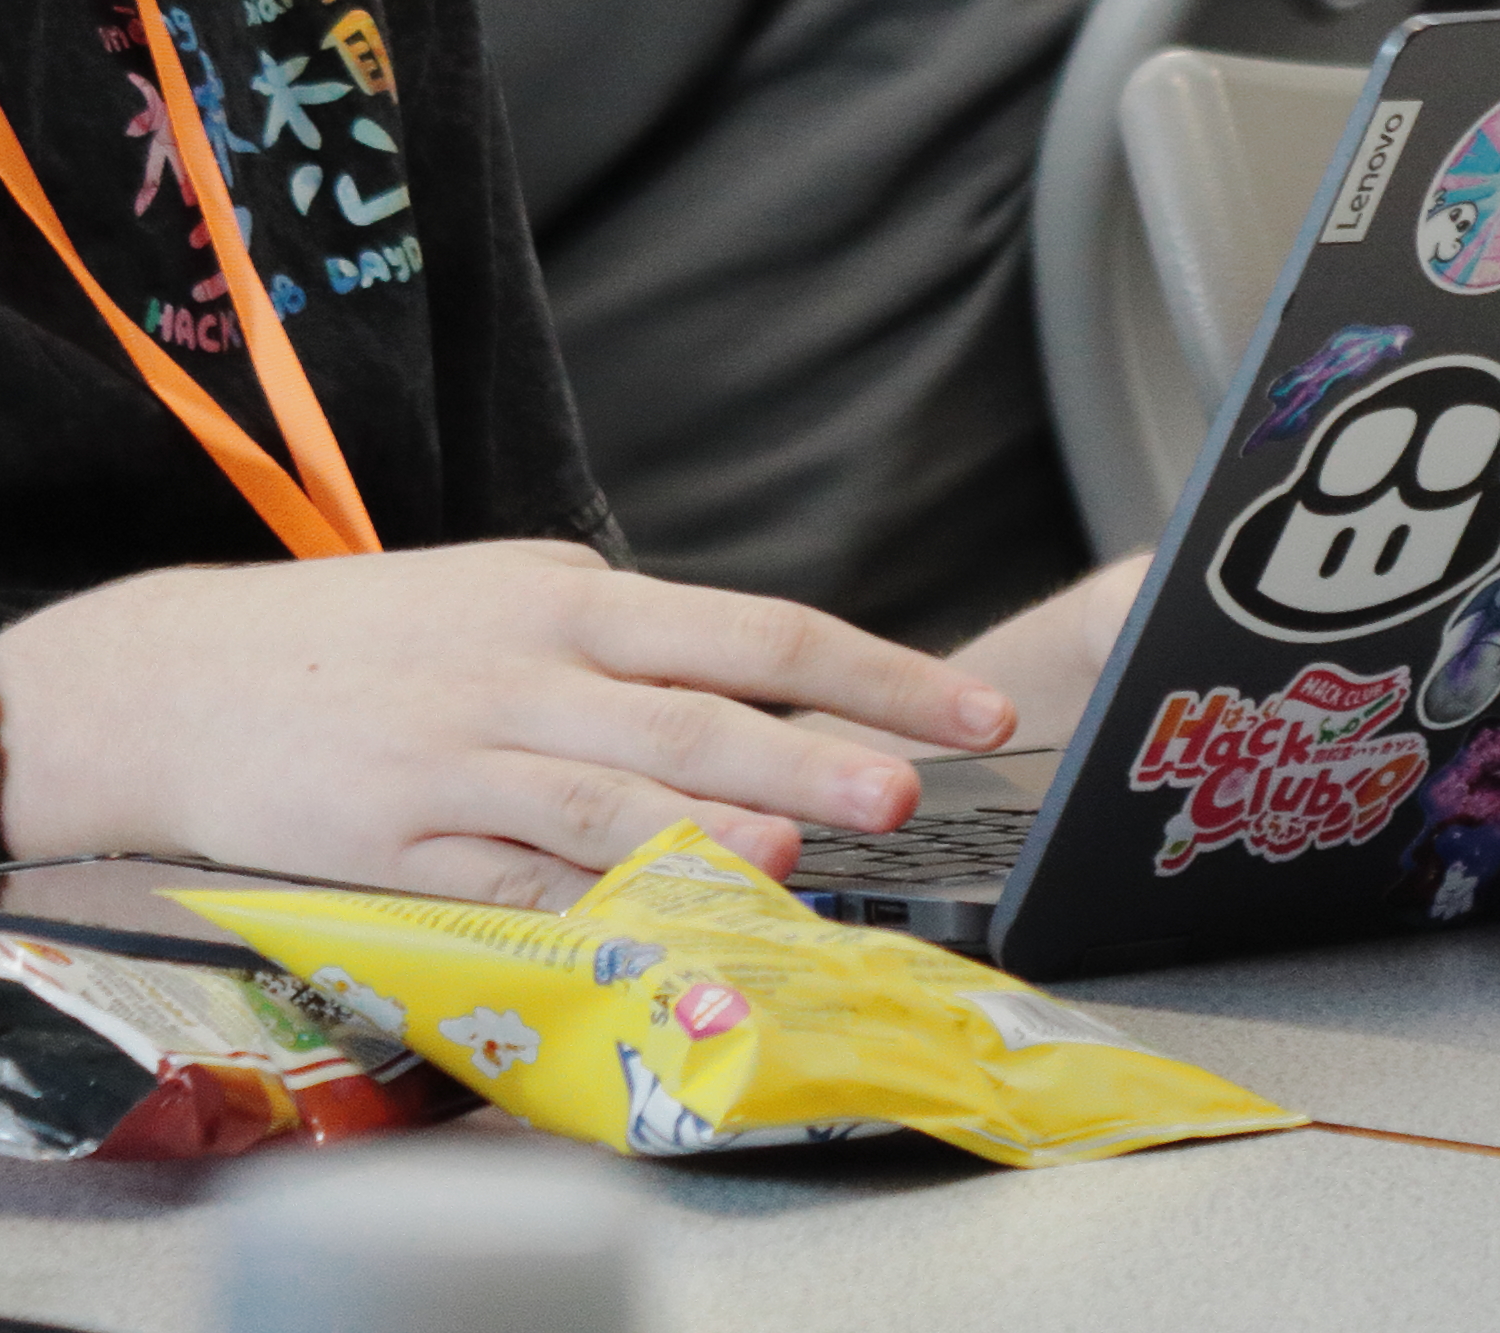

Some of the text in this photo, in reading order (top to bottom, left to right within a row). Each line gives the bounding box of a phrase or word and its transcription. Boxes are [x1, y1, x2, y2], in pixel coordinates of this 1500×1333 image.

[1336, 113, 1404, 230] Lenovo
[145, 297, 243, 353] HACK
[1301, 676, 1345, 707] HACK
[1141, 694, 1314, 769] Hack
[1190, 756, 1344, 830] Club
